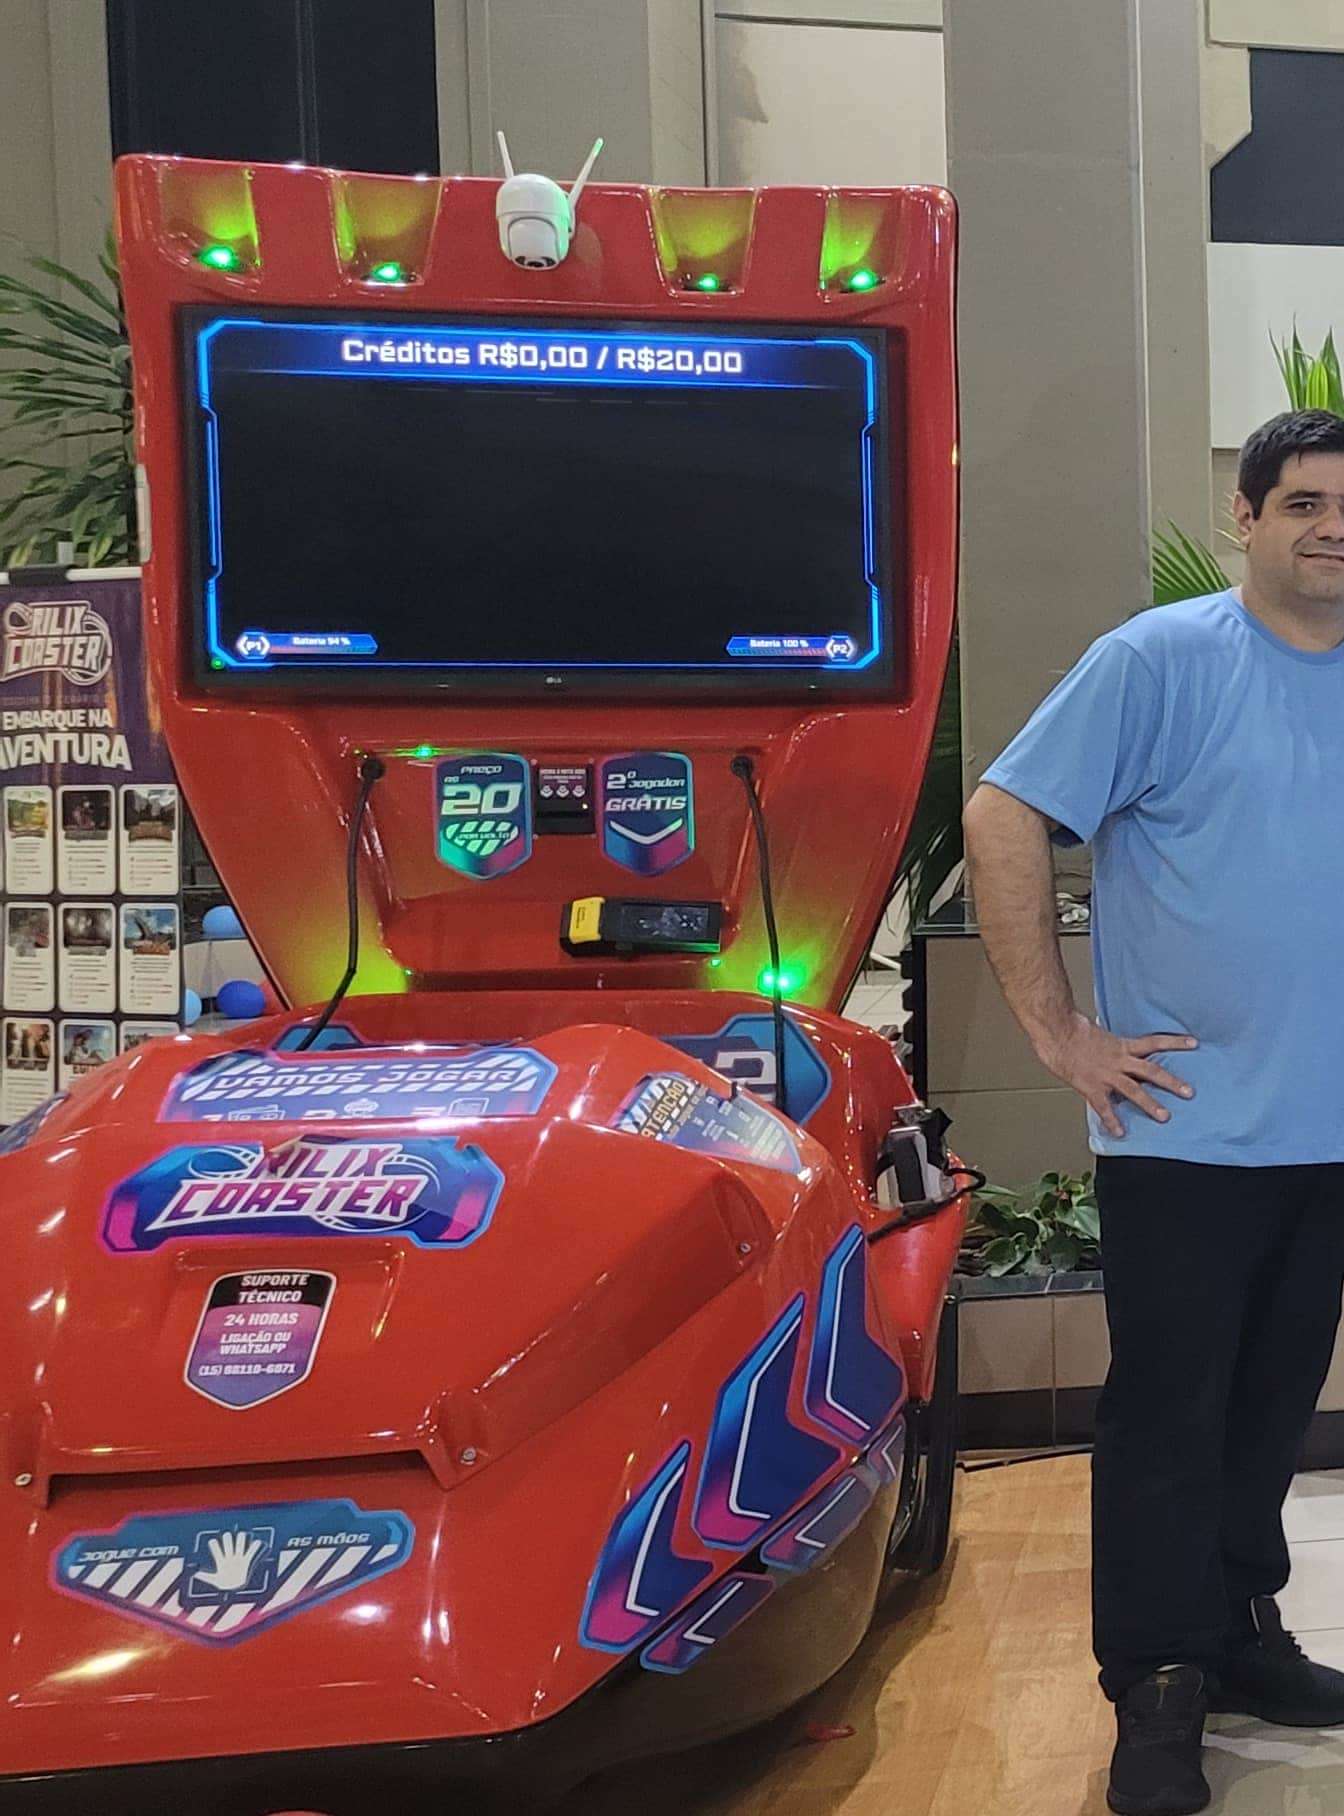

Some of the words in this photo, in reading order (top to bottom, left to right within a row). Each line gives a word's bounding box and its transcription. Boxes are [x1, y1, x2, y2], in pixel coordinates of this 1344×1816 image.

[343, 339, 470, 366] Créditos
[478, 342, 588, 370] R$0,00
[596, 346, 609, 370] /
[617, 347, 742, 375] R$20,00
[6, 635, 103, 674] COASTER
[2, 708, 87, 731] EMBARQUE
[88, 708, 114, 729] NA
[441, 783, 522, 815] 20
[377, 1067, 522, 1084] JOGAR
[252, 1143, 396, 1179] RILIX
[165, 1180, 420, 1222] COASTER
[241, 1273, 310, 1287] SUPORTE
[238, 1289, 303, 1303] TÉCNICO
[223, 1313, 246, 1327] 24
[248, 1312, 299, 1326] HORAS
[219, 1330, 273, 1344] LIGAÇÃO
[274, 1331, 292, 1342] OU
[219, 1343, 287, 1355] WHATSAPP
